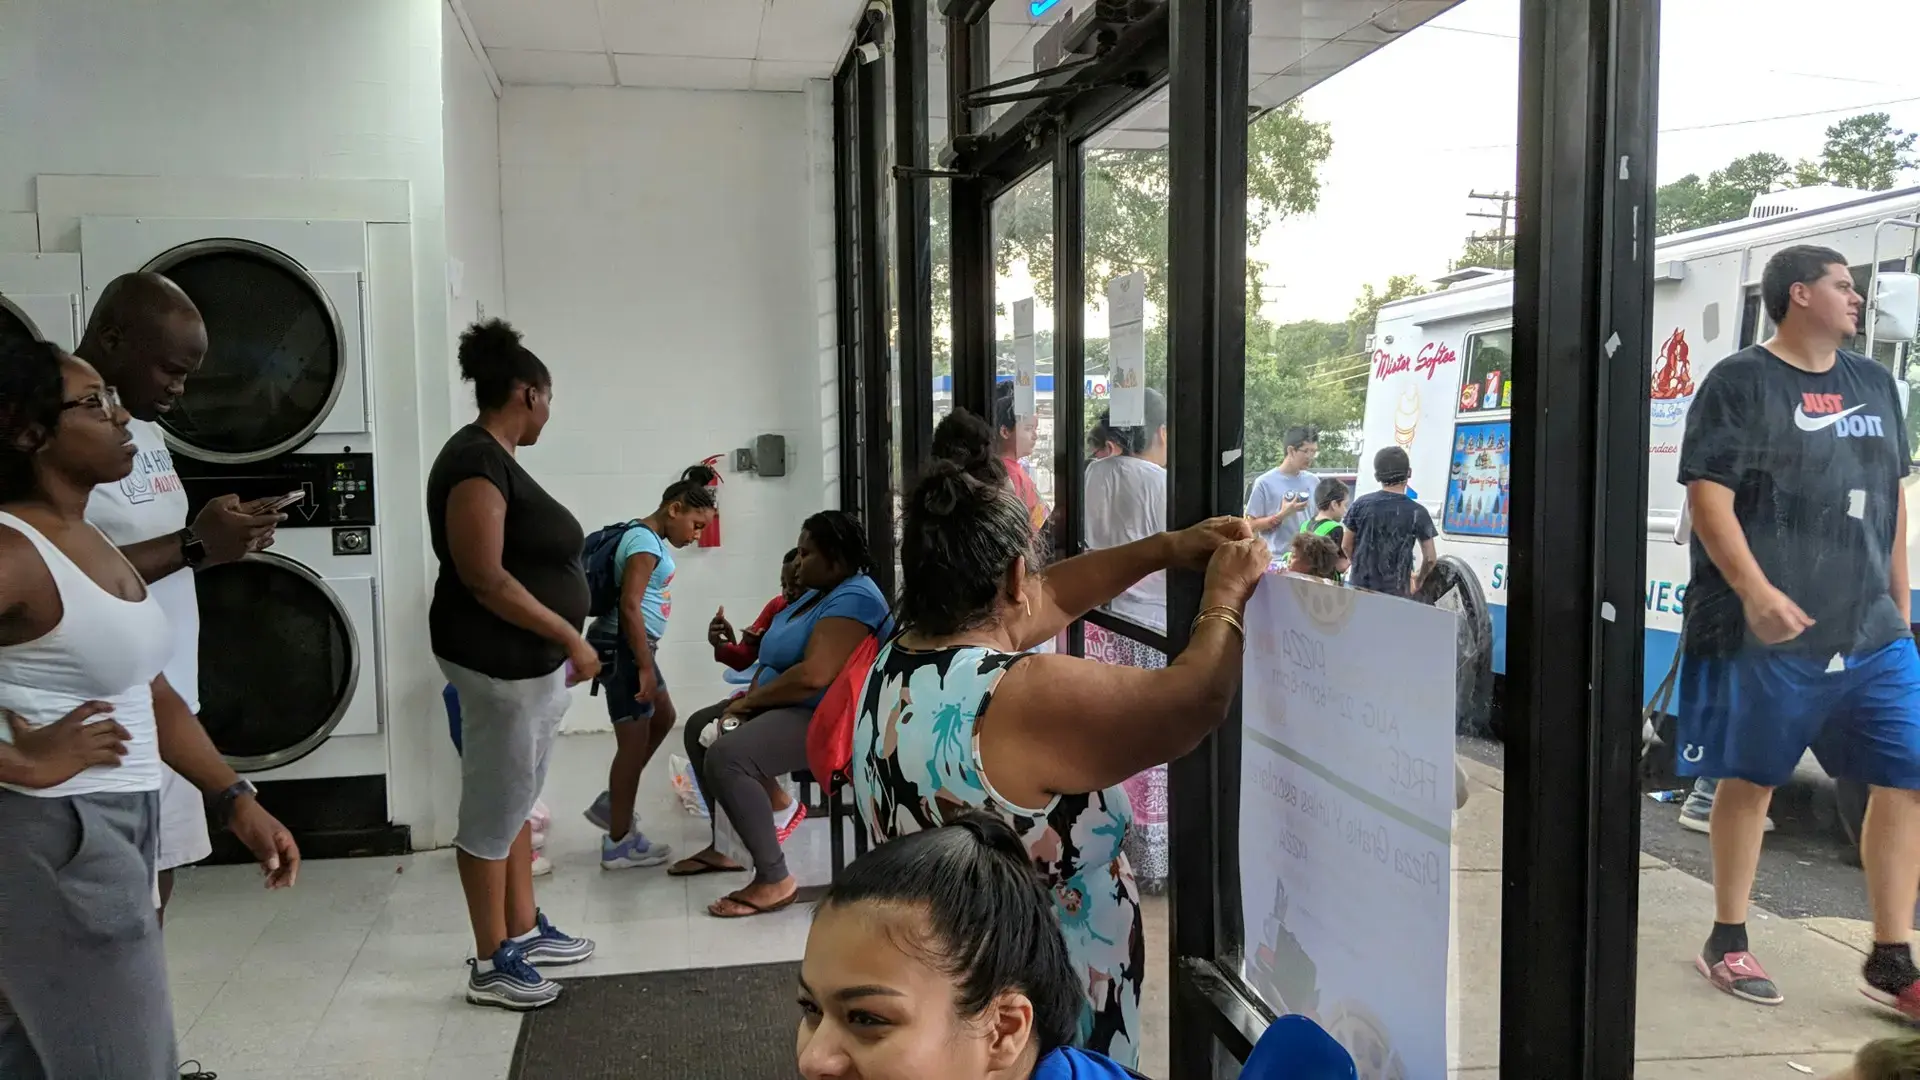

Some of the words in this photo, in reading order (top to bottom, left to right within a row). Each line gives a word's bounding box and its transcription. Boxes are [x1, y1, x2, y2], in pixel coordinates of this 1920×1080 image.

[1374, 349, 1411, 381] Mister
[1415, 341, 1456, 380] Softee
[1802, 392, 1843, 414] JUST
